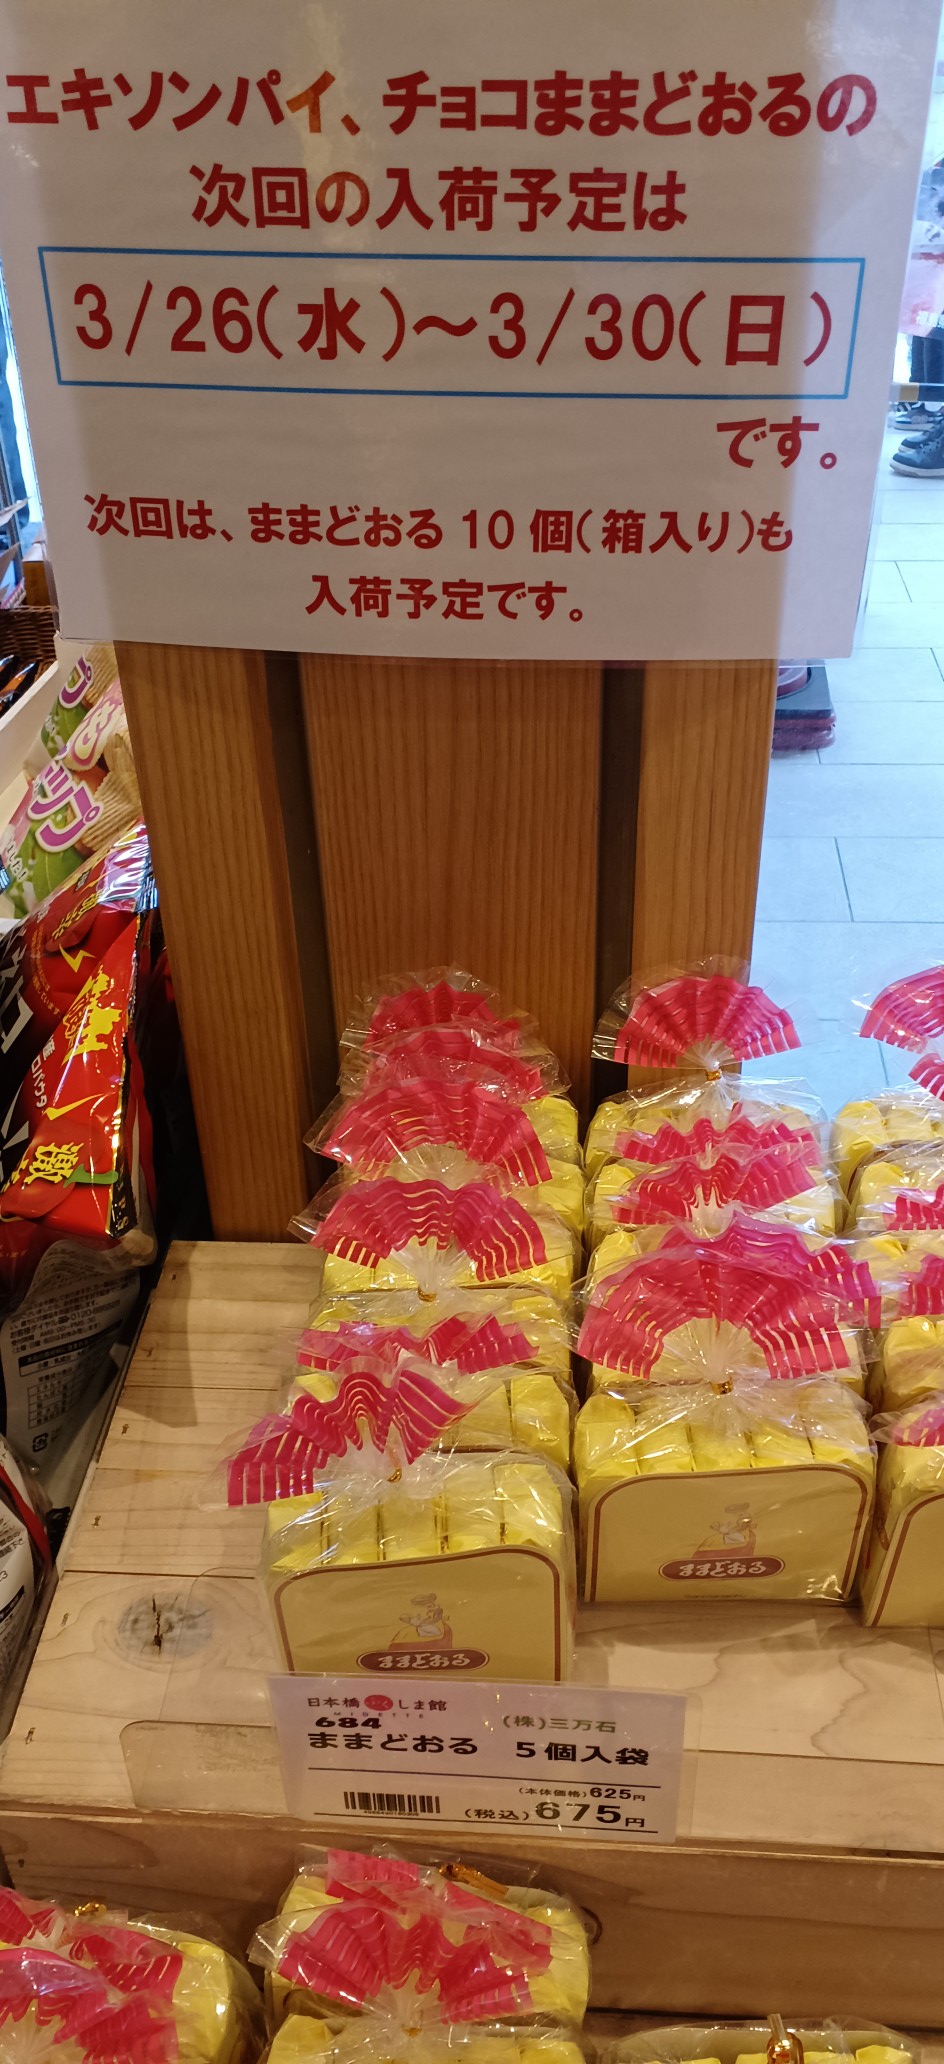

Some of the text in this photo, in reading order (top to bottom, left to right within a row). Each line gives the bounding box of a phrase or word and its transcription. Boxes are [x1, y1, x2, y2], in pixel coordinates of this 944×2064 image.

[6, 69, 876, 137] エキソンパイ、チョコままどおるの
[190, 164, 687, 232] 次回の入荷予定は
[717, 417, 837, 469] です。
[84, 494, 793, 554] 次回は、ままどおる 10 個(箱入り)も
[306, 576, 583, 622] 入荷予定です。
[679, 1560, 767, 1577] ままどおる
[377, 1653, 470, 1670] ままどおる
[315, 1717, 381, 1729] 684
[503, 1715, 616, 1733] (株)三万石
[308, 1732, 649, 1766] ままどおる 5個入袋
